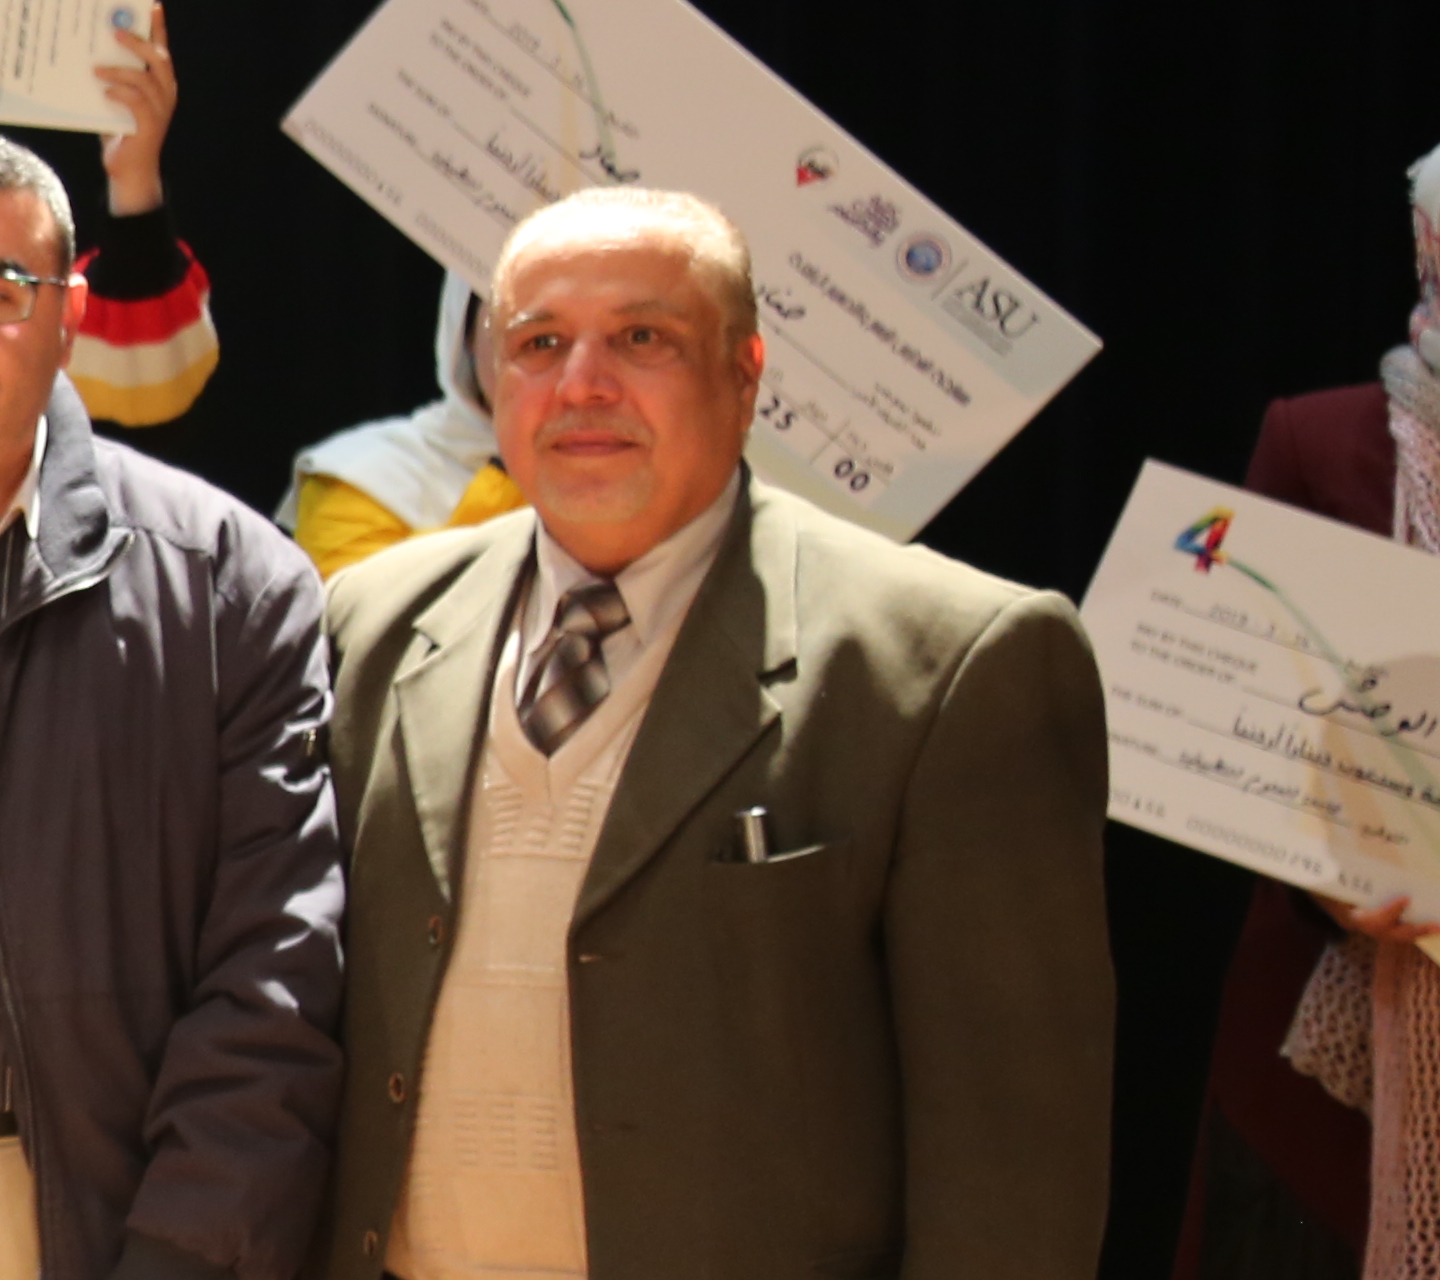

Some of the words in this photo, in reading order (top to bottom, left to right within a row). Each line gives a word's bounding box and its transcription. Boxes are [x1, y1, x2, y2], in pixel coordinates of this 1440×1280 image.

[955, 273, 1040, 339] ASU
[759, 398, 798, 433] 25
[832, 458, 872, 494] 00
[1173, 506, 1236, 575] 4
